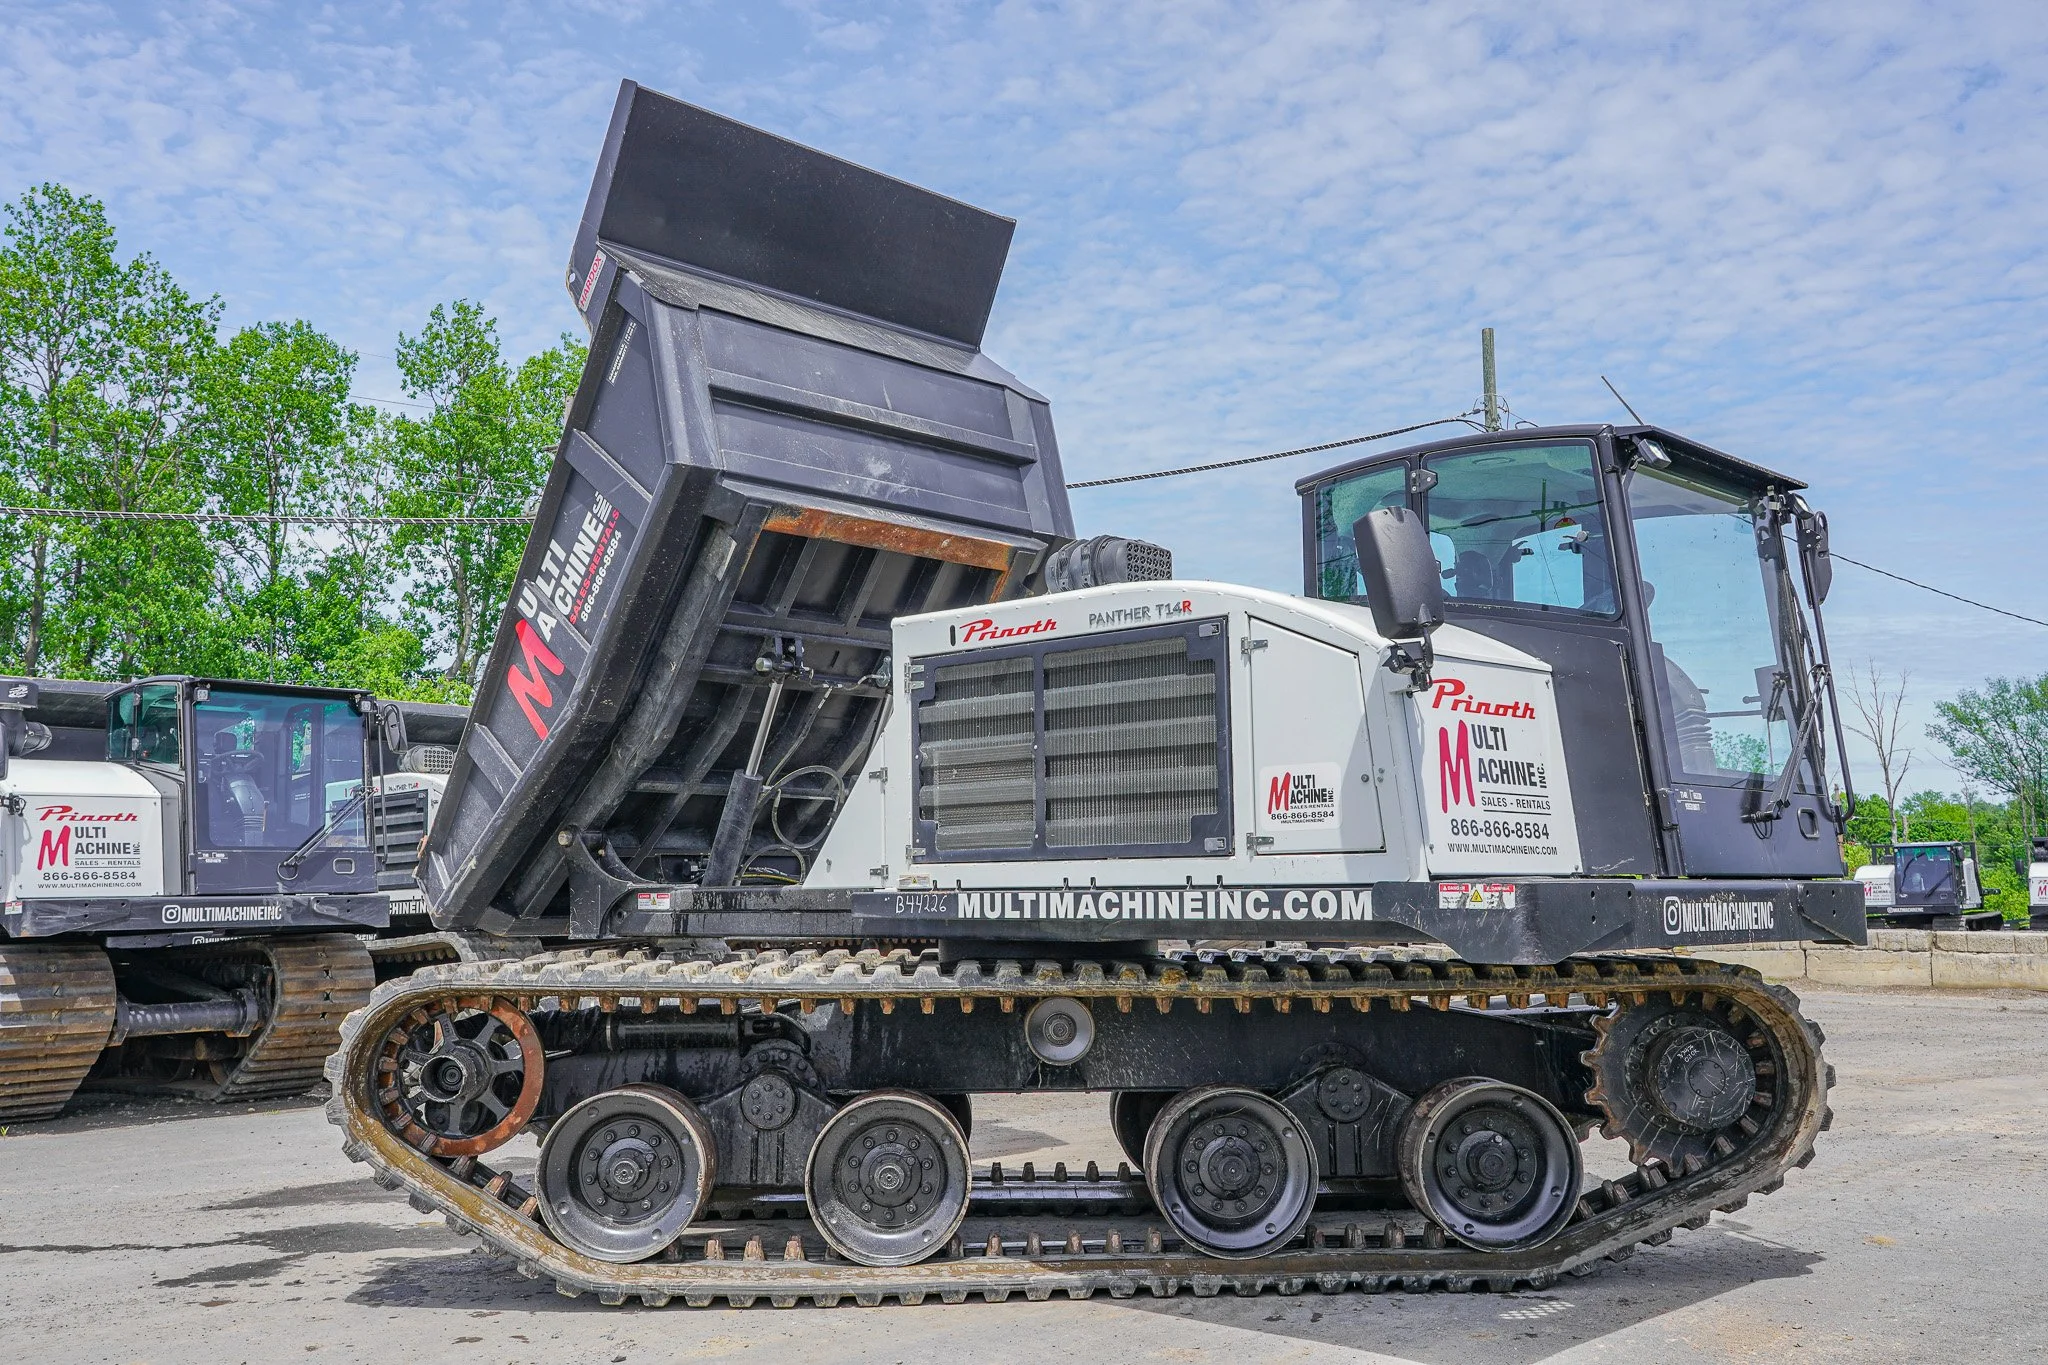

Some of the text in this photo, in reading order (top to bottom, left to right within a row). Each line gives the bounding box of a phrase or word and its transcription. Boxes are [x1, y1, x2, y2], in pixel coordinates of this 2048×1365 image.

[580, 255, 602, 307] HARDOX
[580, 529, 622, 622] 866-866-8584
[1088, 600, 1192, 627] PANTHER T14R
[960, 619, 1057, 643] Prinoth
[1428, 678, 1536, 720] Prinoth
[1537, 763, 1547, 789] INC.
[35, 805, 139, 822] Prinoth
[1481, 796, 1507, 808] SALES
[1516, 798, 1551, 810] RENTALS
[1271, 811, 1335, 821] 866-866-8584
[1450, 818, 1550, 840] 866-866-8584
[133, 842, 141, 855] INC.
[1447, 843, 1558, 856] WWW.MULTIMACHINEINC.COM
[43, 871, 137, 881] 866-866-8584
[181, 906, 282, 922] MULTIMACHINEINC
[896, 894, 948, 914] B44226
[957, 890, 1373, 921] MULTIMACHINEINC.COM
[1682, 901, 1774, 933] MULTIMACHINEINC
